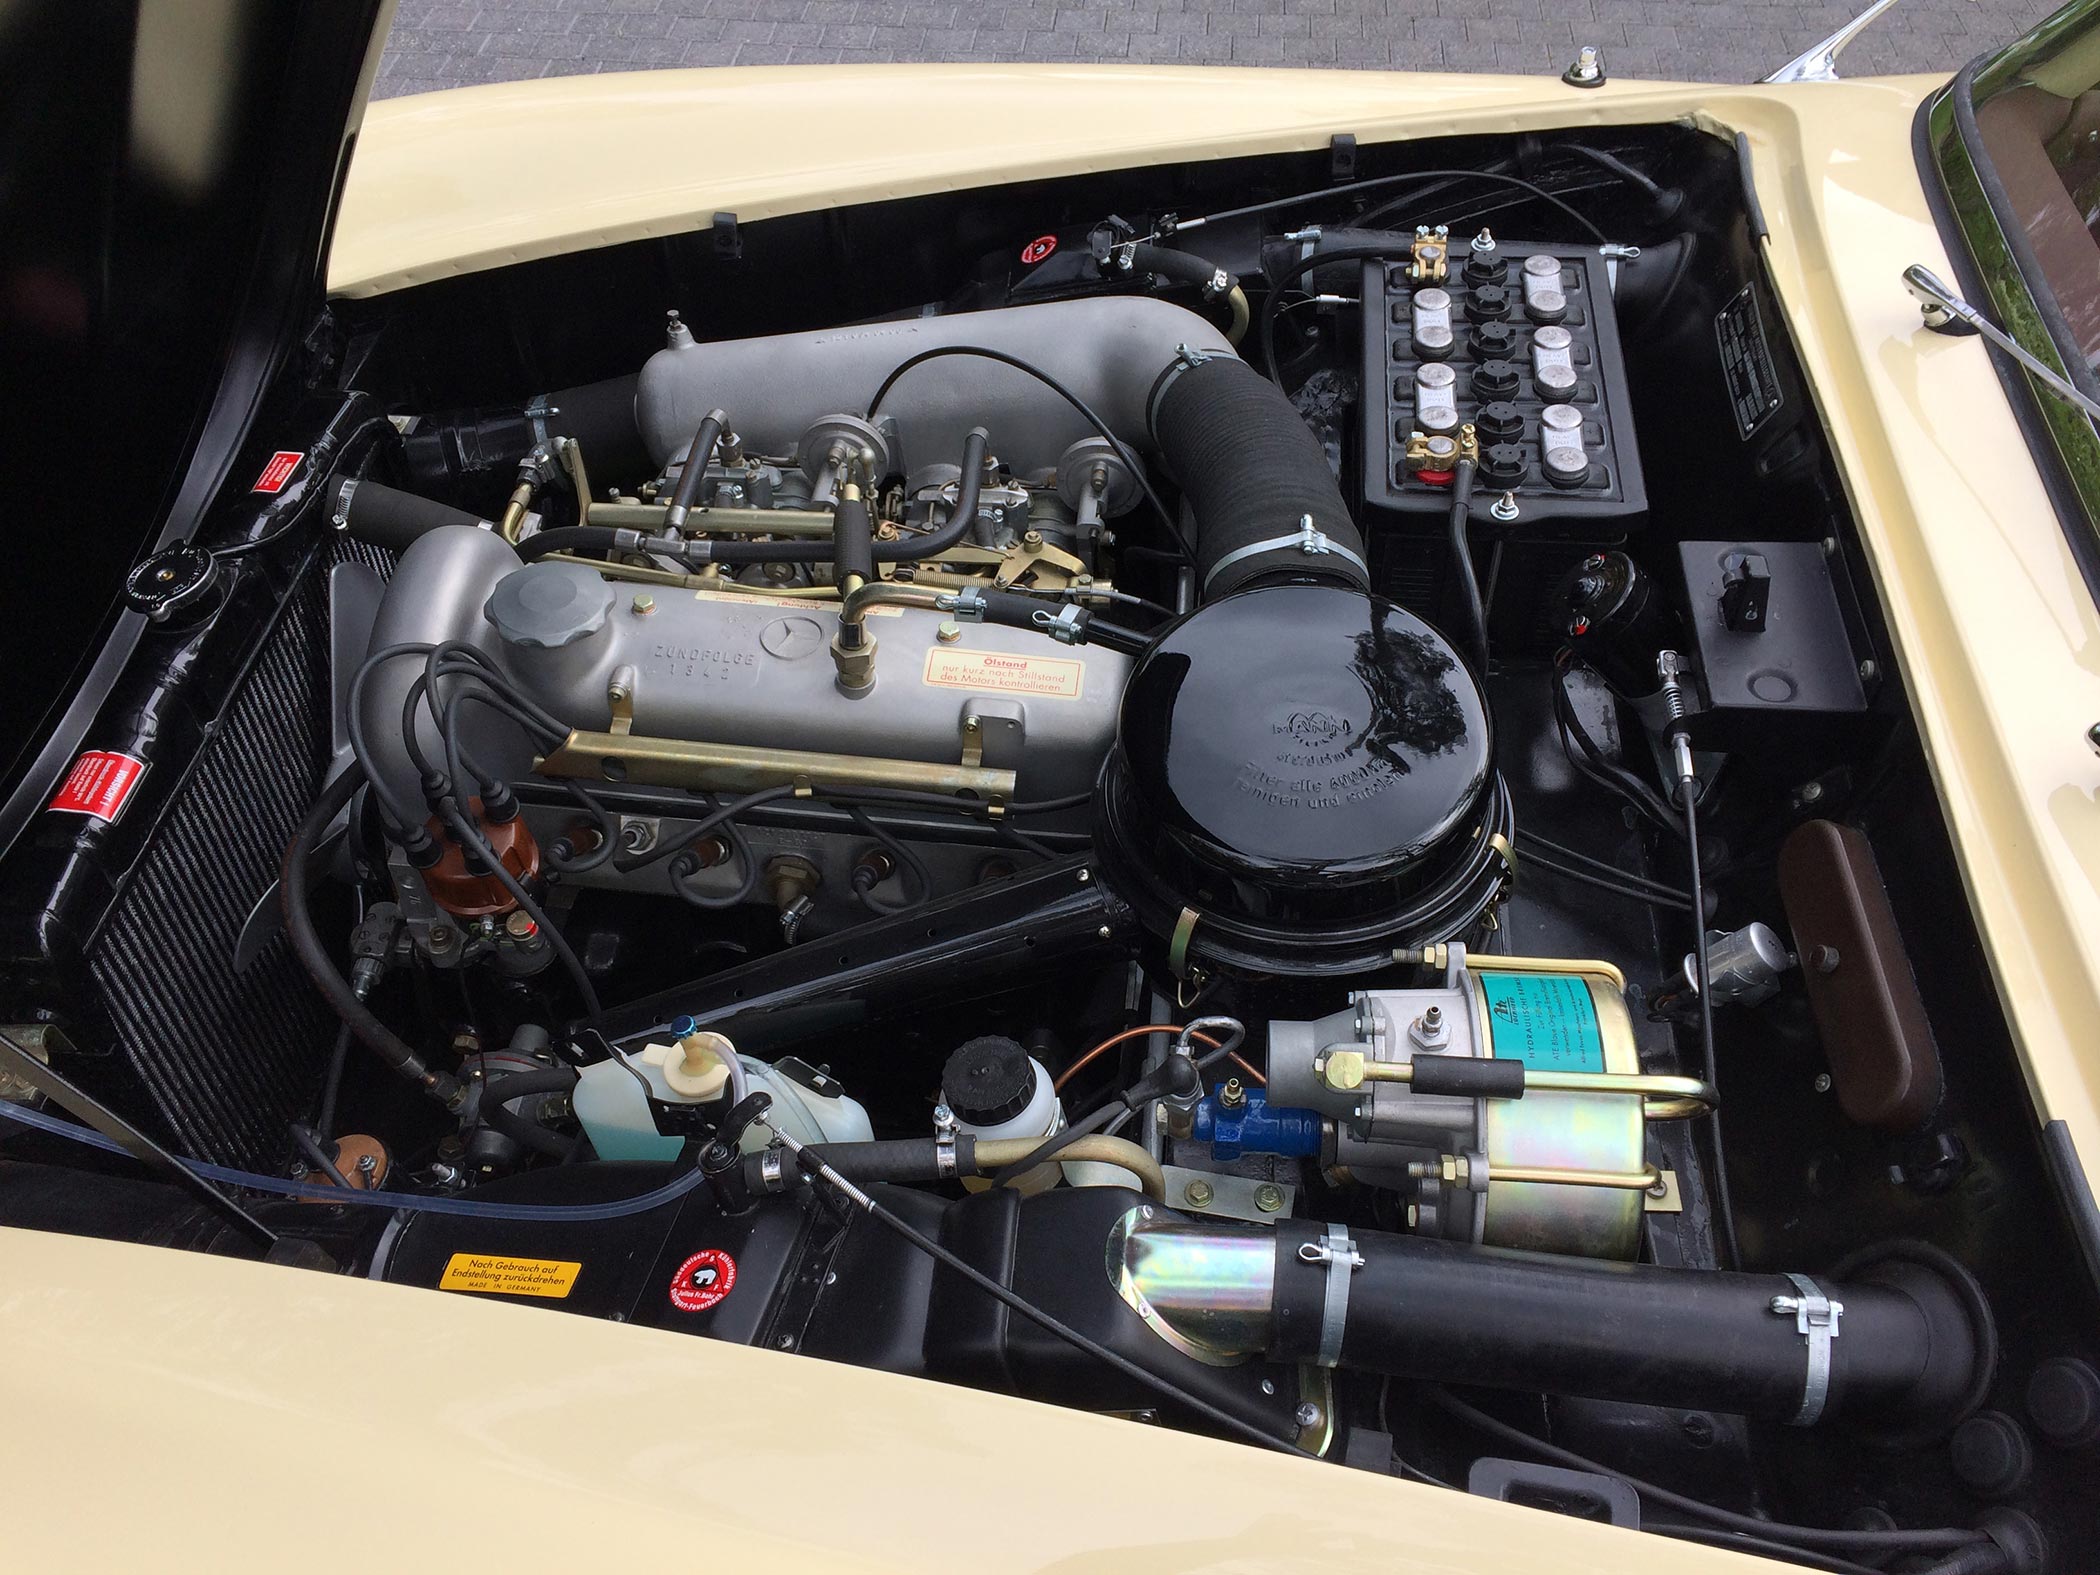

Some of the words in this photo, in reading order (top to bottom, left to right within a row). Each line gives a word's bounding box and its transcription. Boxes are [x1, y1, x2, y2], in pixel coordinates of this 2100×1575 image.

[983, 657, 1027, 669] Ölstand
[940, 673, 957, 681] des
[960, 674, 996, 685] Motors
[1000, 679, 1061, 692] kontrollieren
[963, 665, 985, 674] kurz
[989, 669, 1014, 678] nach
[1019, 671, 1065, 683] Stillstand
[1520, 997, 1535, 1059] HYDRAULISCHE
[469, 1260, 493, 1269] Nach
[495, 1261, 540, 1273] Gebrauch
[541, 1265, 559, 1274] auf
[451, 1268, 502, 1282] Endstellung
[503, 1273, 565, 1286] zurückdrehen
